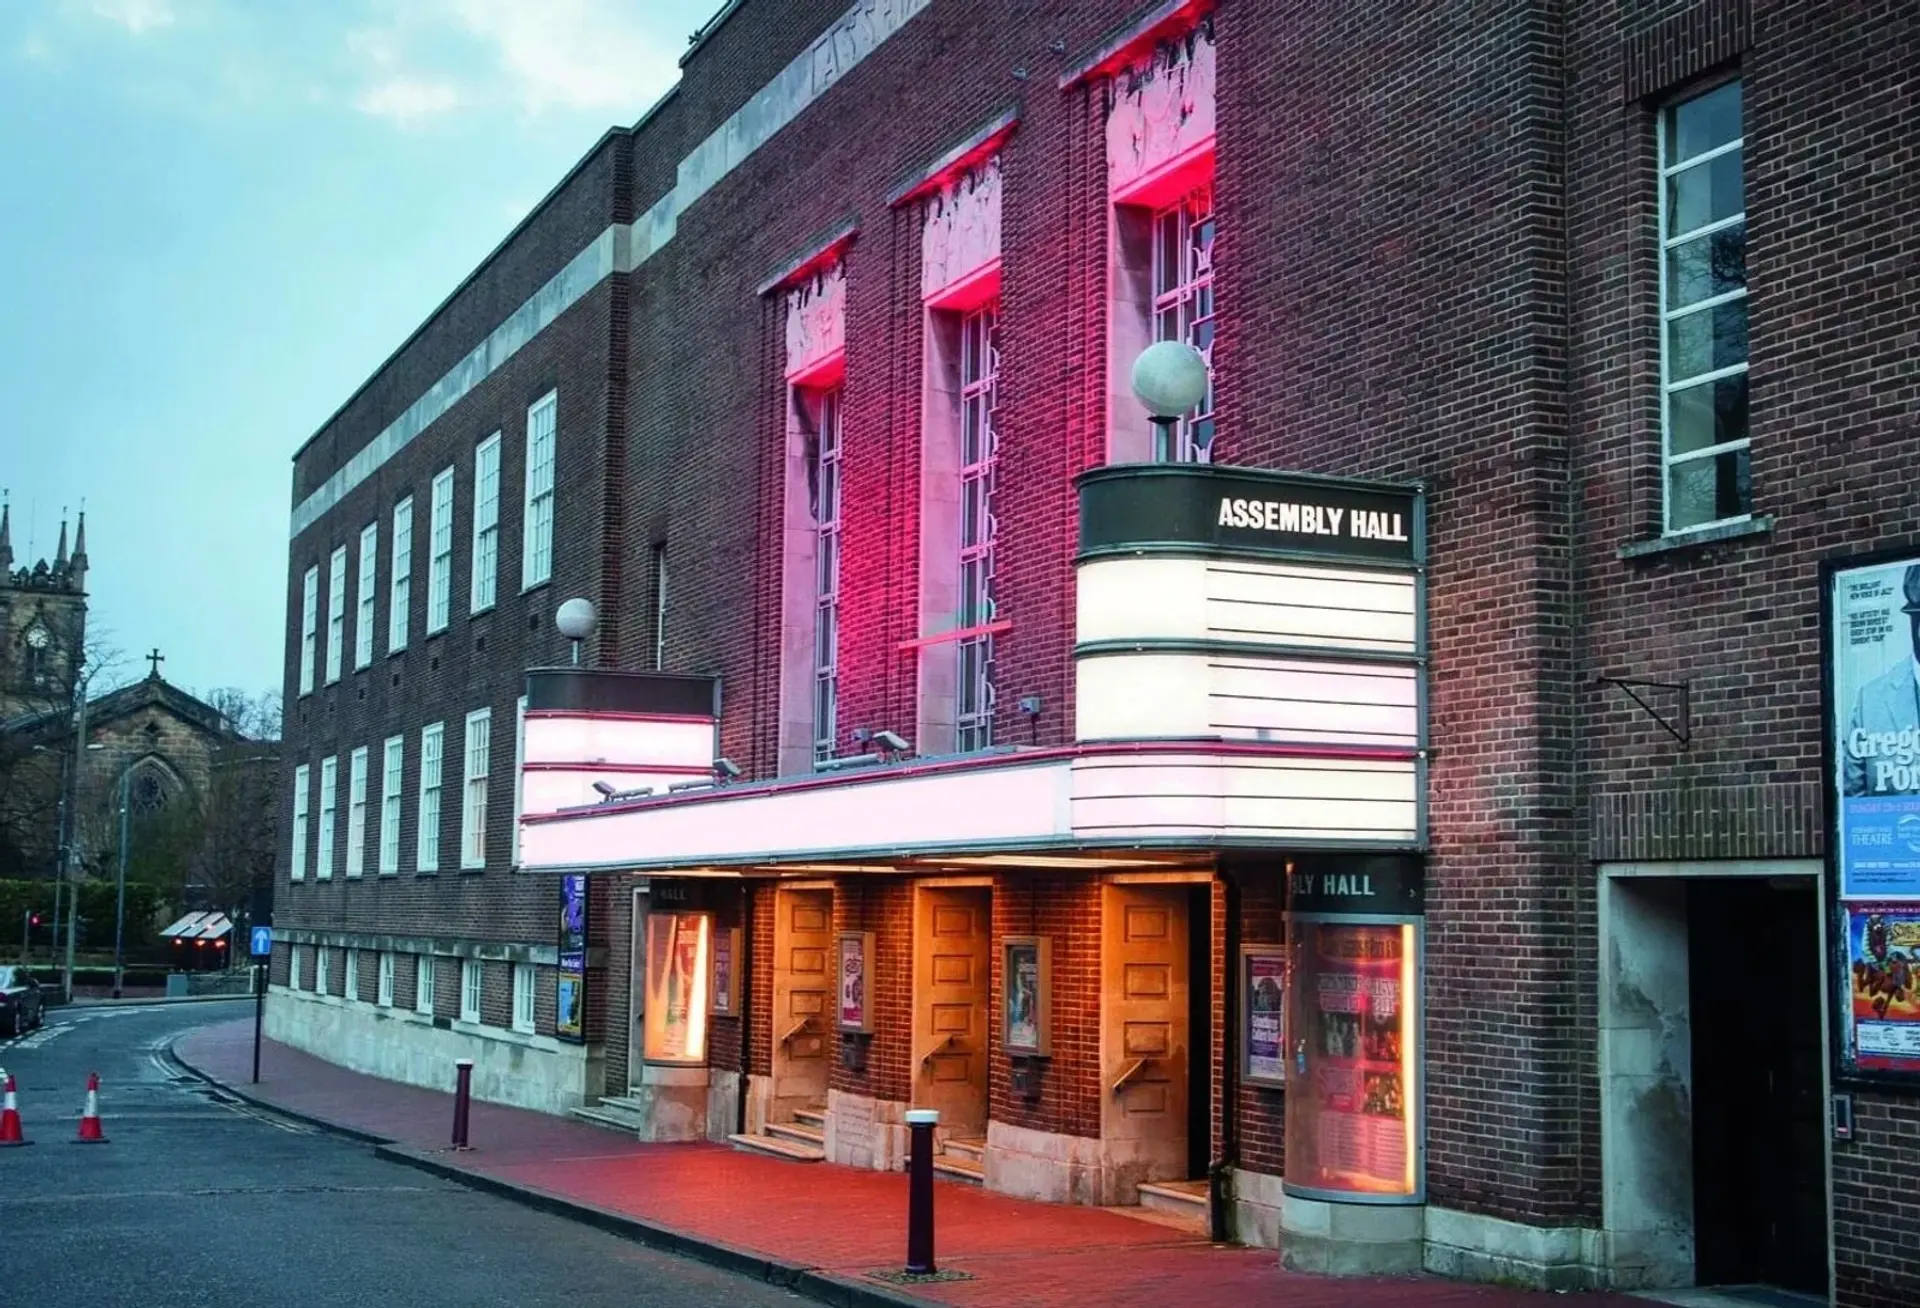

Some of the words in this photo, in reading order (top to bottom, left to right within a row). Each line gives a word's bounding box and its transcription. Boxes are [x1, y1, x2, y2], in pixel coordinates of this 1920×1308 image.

[1218, 497, 1344, 536] ASSEMBLY
[1350, 509, 1409, 543] HALL
[1322, 873, 1376, 896] HALL
